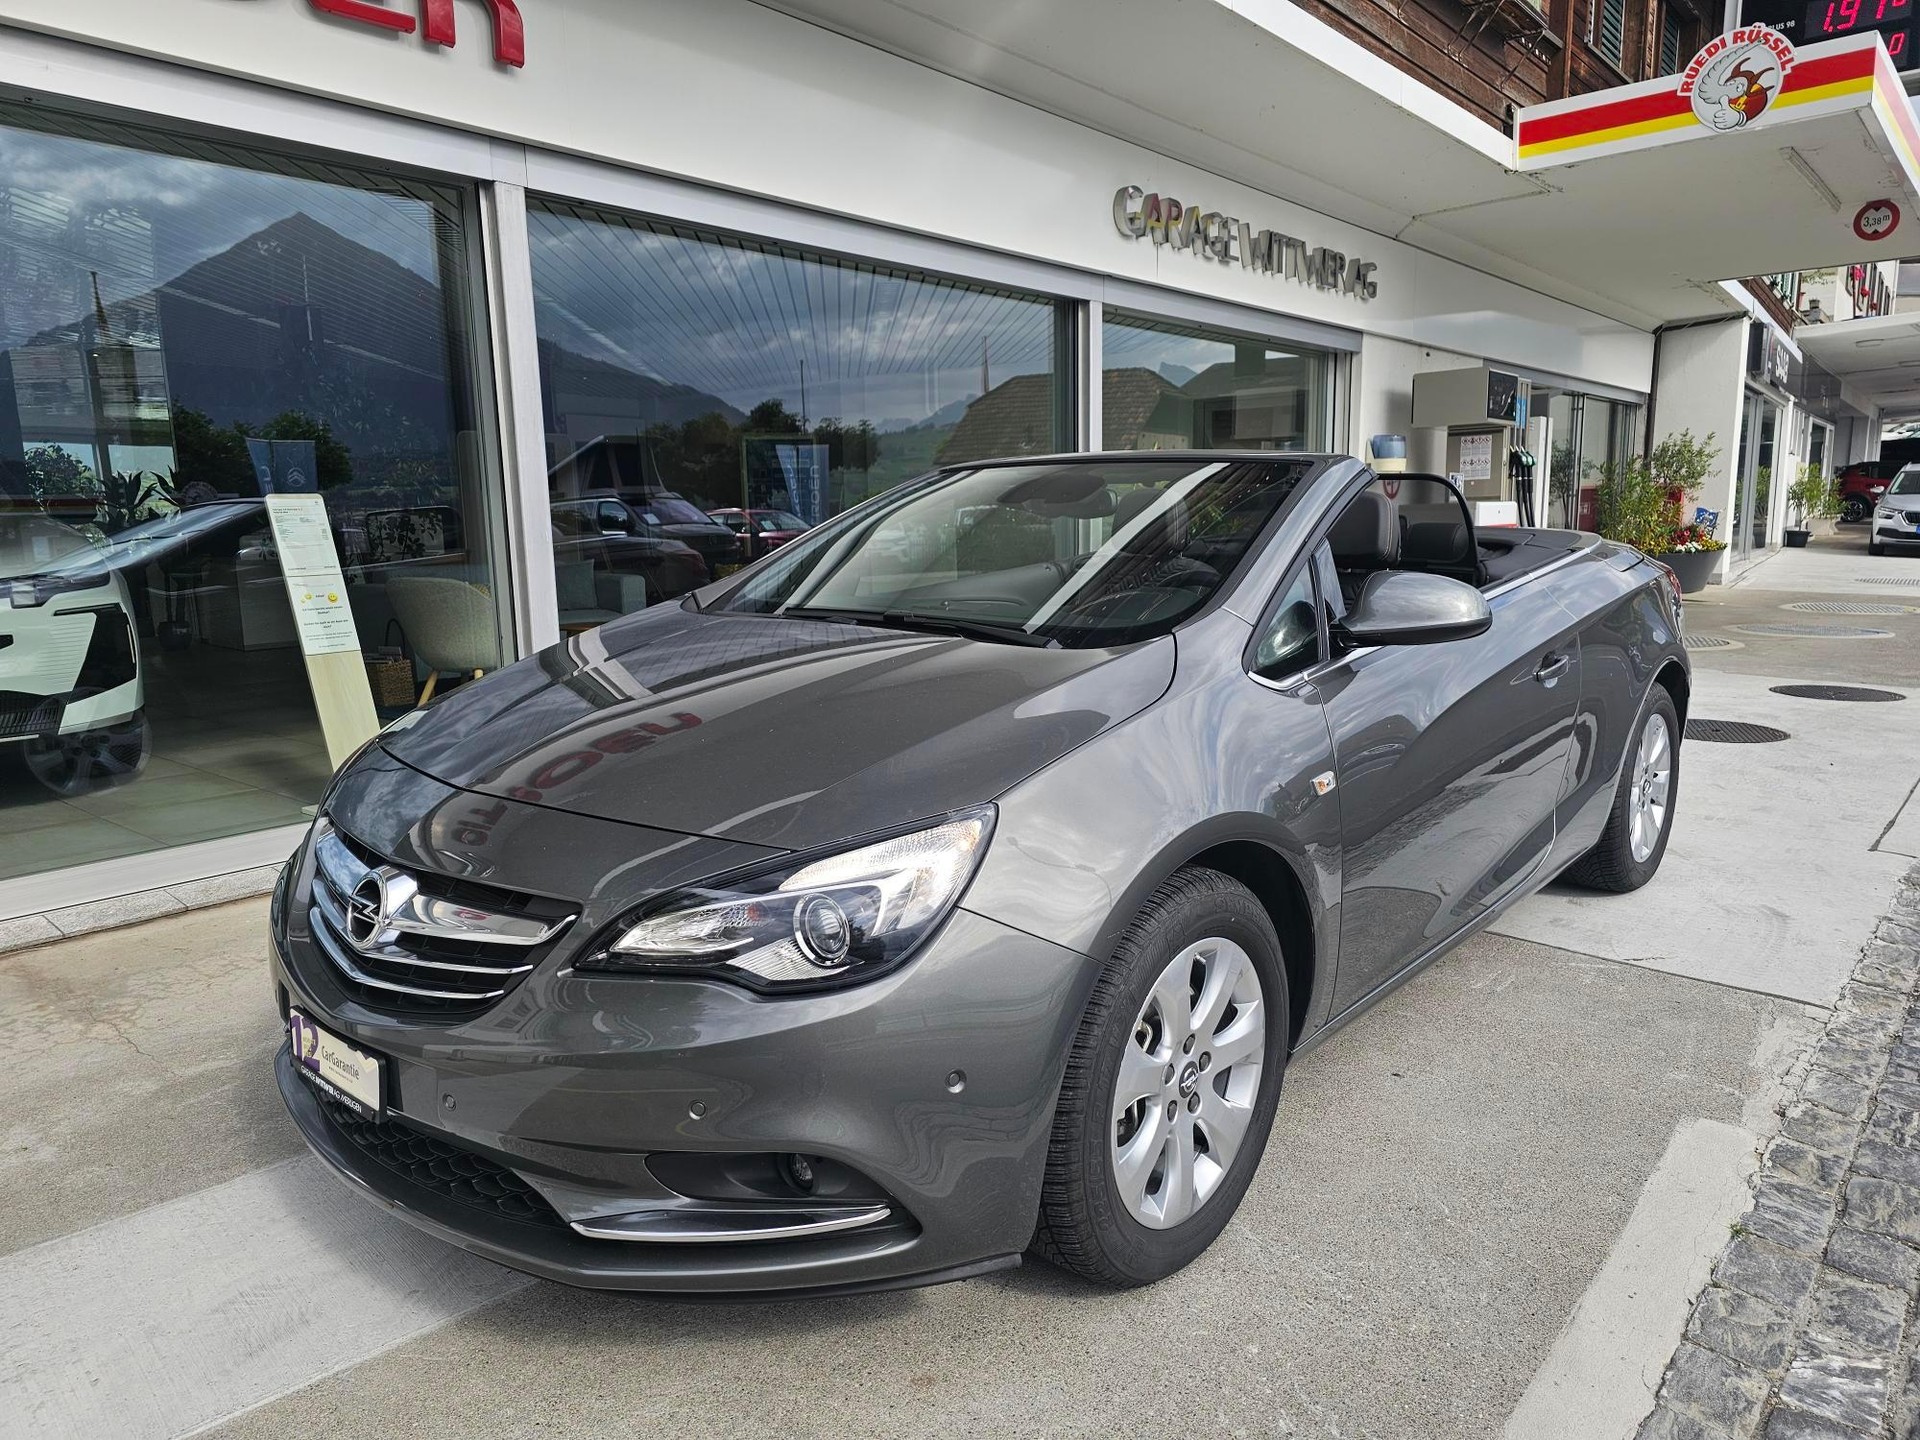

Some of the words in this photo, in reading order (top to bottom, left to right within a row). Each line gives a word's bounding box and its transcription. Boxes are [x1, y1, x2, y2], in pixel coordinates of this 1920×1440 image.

[1786, 20, 1795, 28] 98
[1680, 37, 1727, 93] RUEDI
[1733, 24, 1795, 72] RÜSSEL
[1112, 184, 1240, 263] GARAGE
[1238, 222, 1346, 294] WITTWER
[1344, 257, 1377, 299] AG
[321, 1045, 360, 1081] CarGarantie
